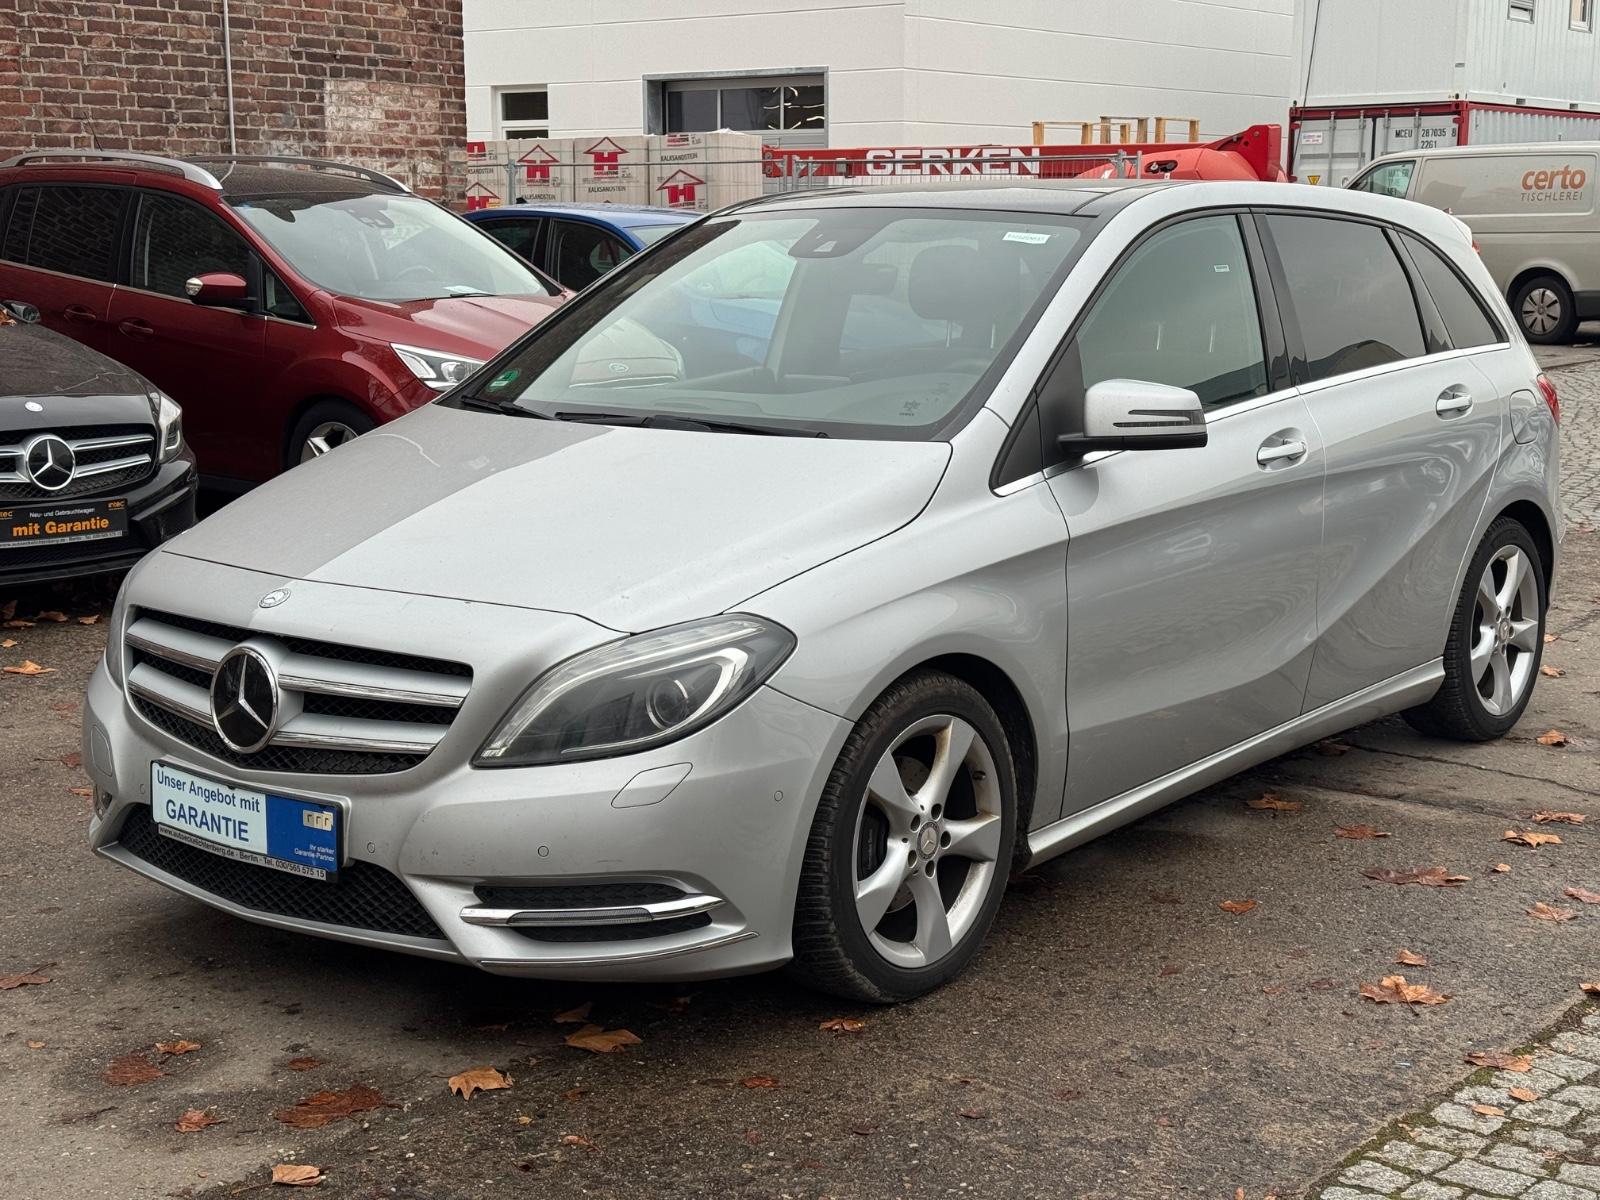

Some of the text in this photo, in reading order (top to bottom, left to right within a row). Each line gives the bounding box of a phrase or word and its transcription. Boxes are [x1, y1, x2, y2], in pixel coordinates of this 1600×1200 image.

[1395, 129, 1412, 138] MCEU
[1421, 128, 1447, 138] 287035
[660, 152, 698, 161] KALKSANDSTEIN
[865, 147, 1040, 175] GERKEN
[1521, 164, 1586, 190] certo
[1520, 191, 1583, 201] TISCHLEREI
[12, 516, 109, 537] mit Garantie
[157, 769, 260, 813] Unser Angebot mit
[166, 799, 249, 842] GARANTIE
[239, 851, 259, 863] Berlin
[302, 867, 314, 876] 575
[316, 870, 325, 878] 15
